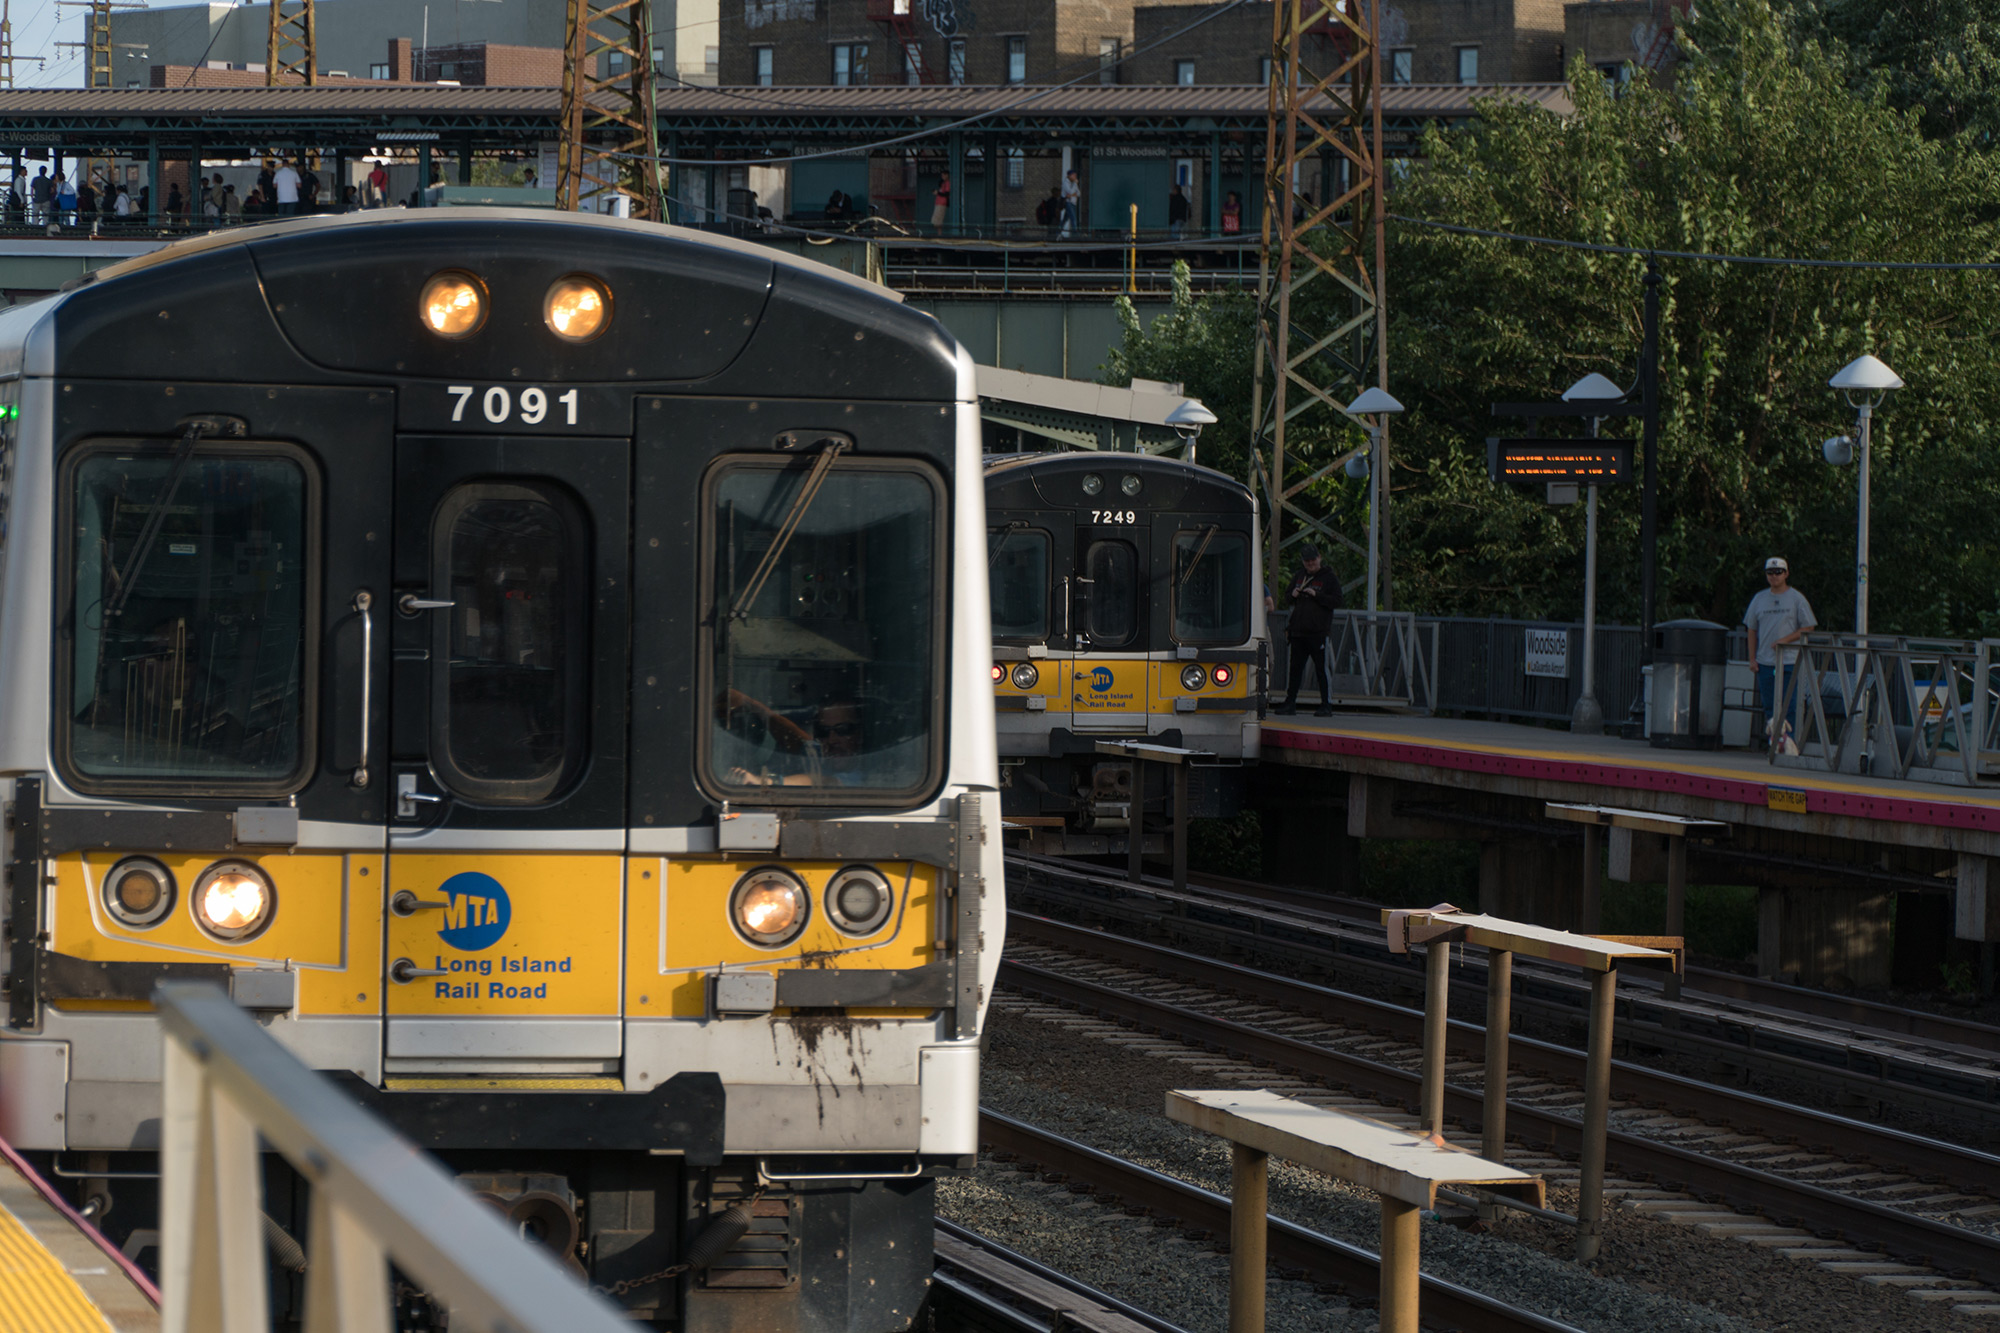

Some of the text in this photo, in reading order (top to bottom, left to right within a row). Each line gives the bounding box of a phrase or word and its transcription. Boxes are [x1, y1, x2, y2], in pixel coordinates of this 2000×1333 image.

[794, 146, 805, 156] 61
[1092, 146, 1167, 157] 61 St-Woodside
[447, 386, 578, 426] 7091
[1091, 510, 1136, 525] 7249
[1526, 631, 1566, 656] Woodside
[1091, 673, 1110, 687] MTA
[1768, 790, 1805, 805] WATCH THE GAP
[440, 889, 500, 932] MTA
[435, 956, 572, 977] Long Island
[435, 982, 547, 999] Rail Road
